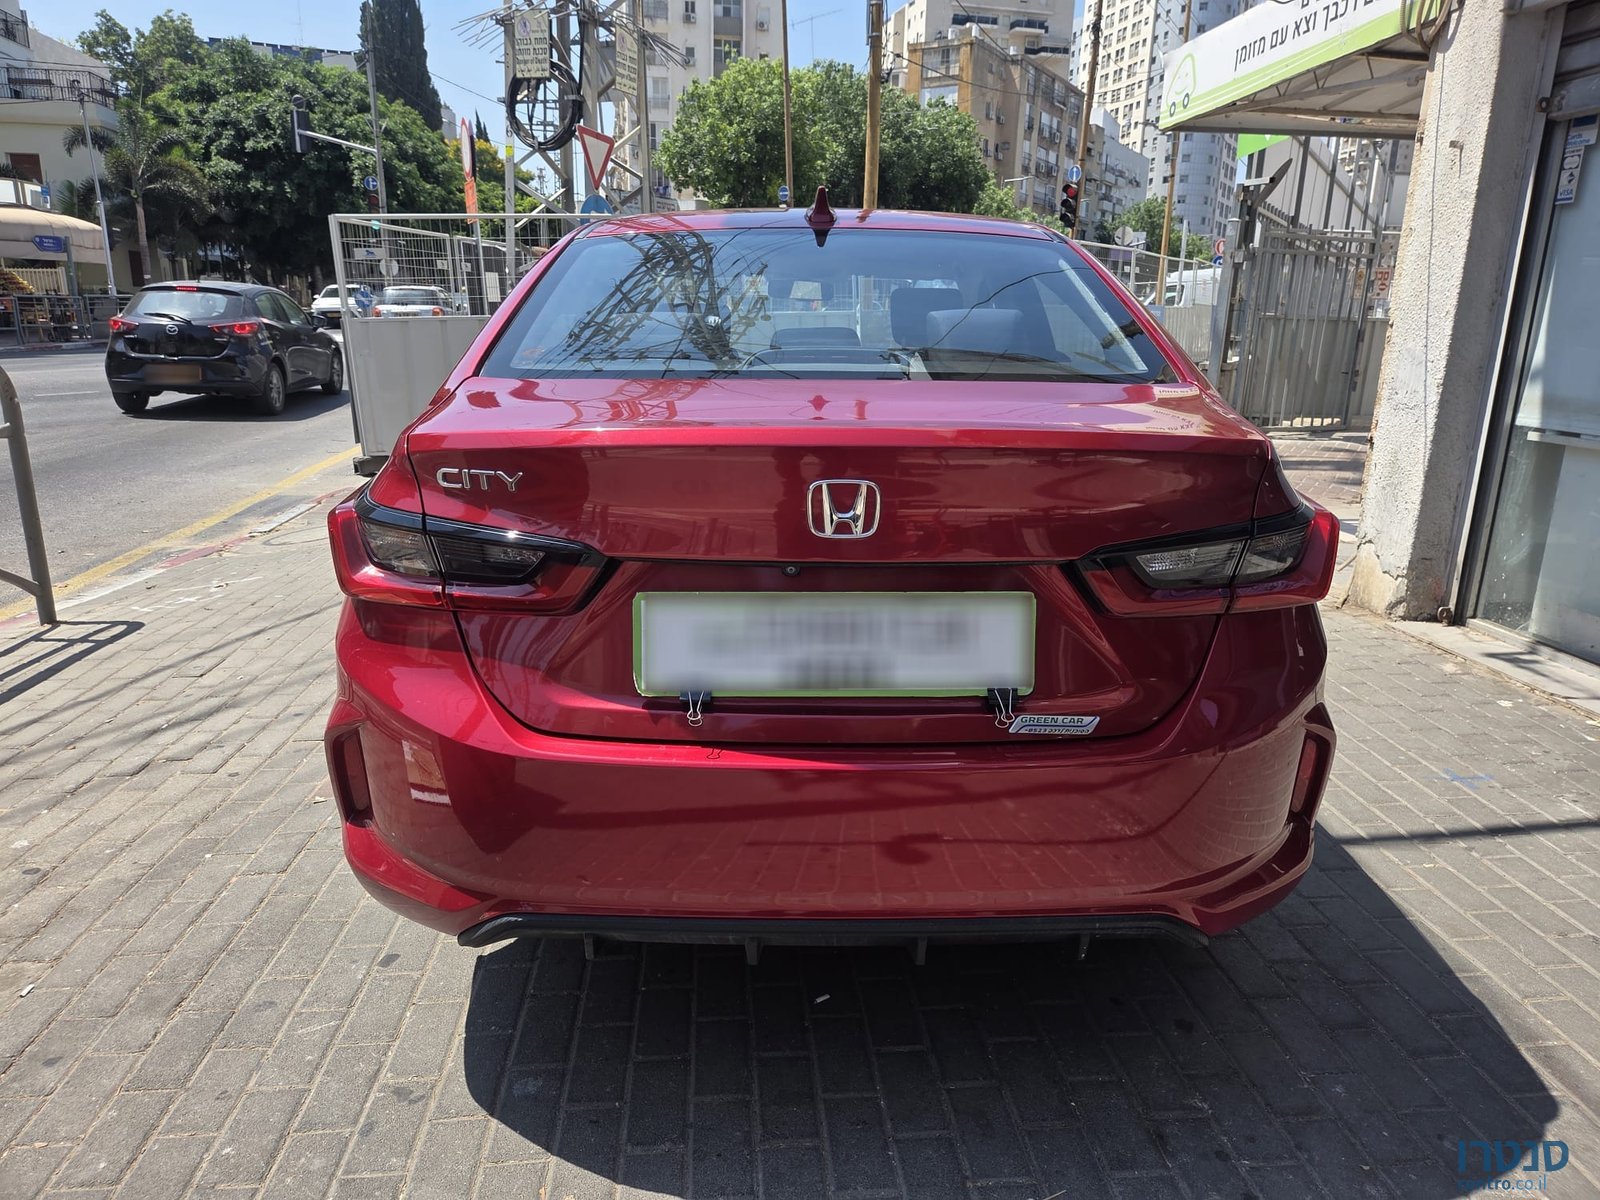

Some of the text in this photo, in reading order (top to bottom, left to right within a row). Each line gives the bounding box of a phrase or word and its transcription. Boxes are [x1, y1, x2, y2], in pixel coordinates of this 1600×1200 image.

[1269, 24, 1289, 50] עם
[1292, 10, 1318, 40] וצא
[1234, 35, 1266, 73] מזומן
[1560, 188, 1574, 197] VISA
[436, 467, 523, 492] CITY
[1020, 716, 1059, 724] GREEN
